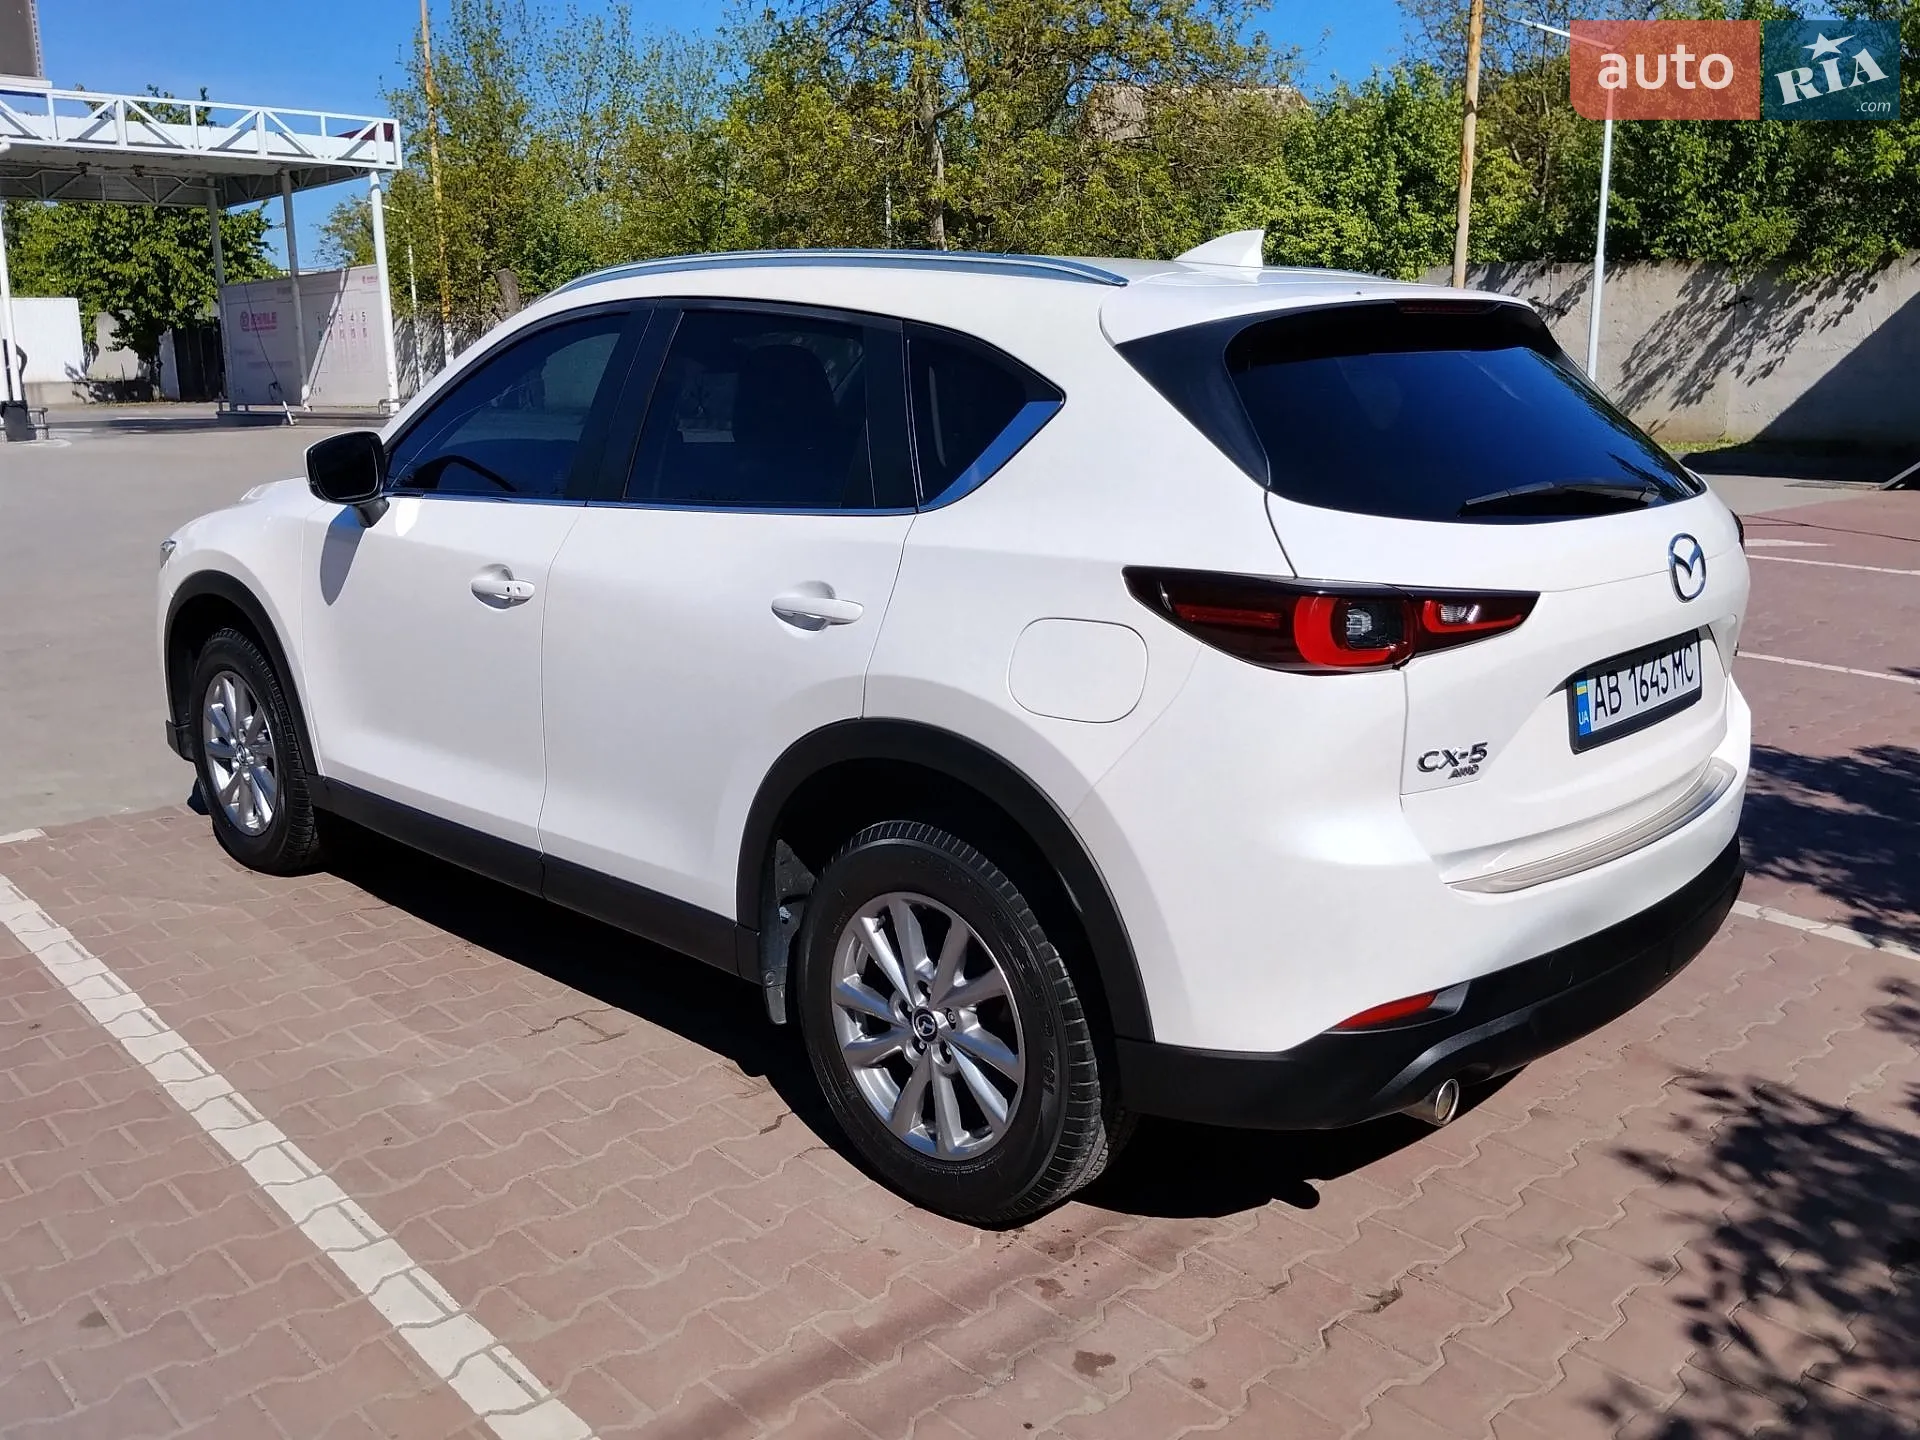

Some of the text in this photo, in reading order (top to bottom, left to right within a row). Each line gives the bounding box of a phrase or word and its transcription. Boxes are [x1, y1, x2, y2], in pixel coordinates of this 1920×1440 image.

[1594, 644, 1694, 721] AB 1645 MC
[1578, 711, 1590, 725] UA
[1417, 742, 1488, 773] CX-5
[1448, 764, 1480, 780] AWD
